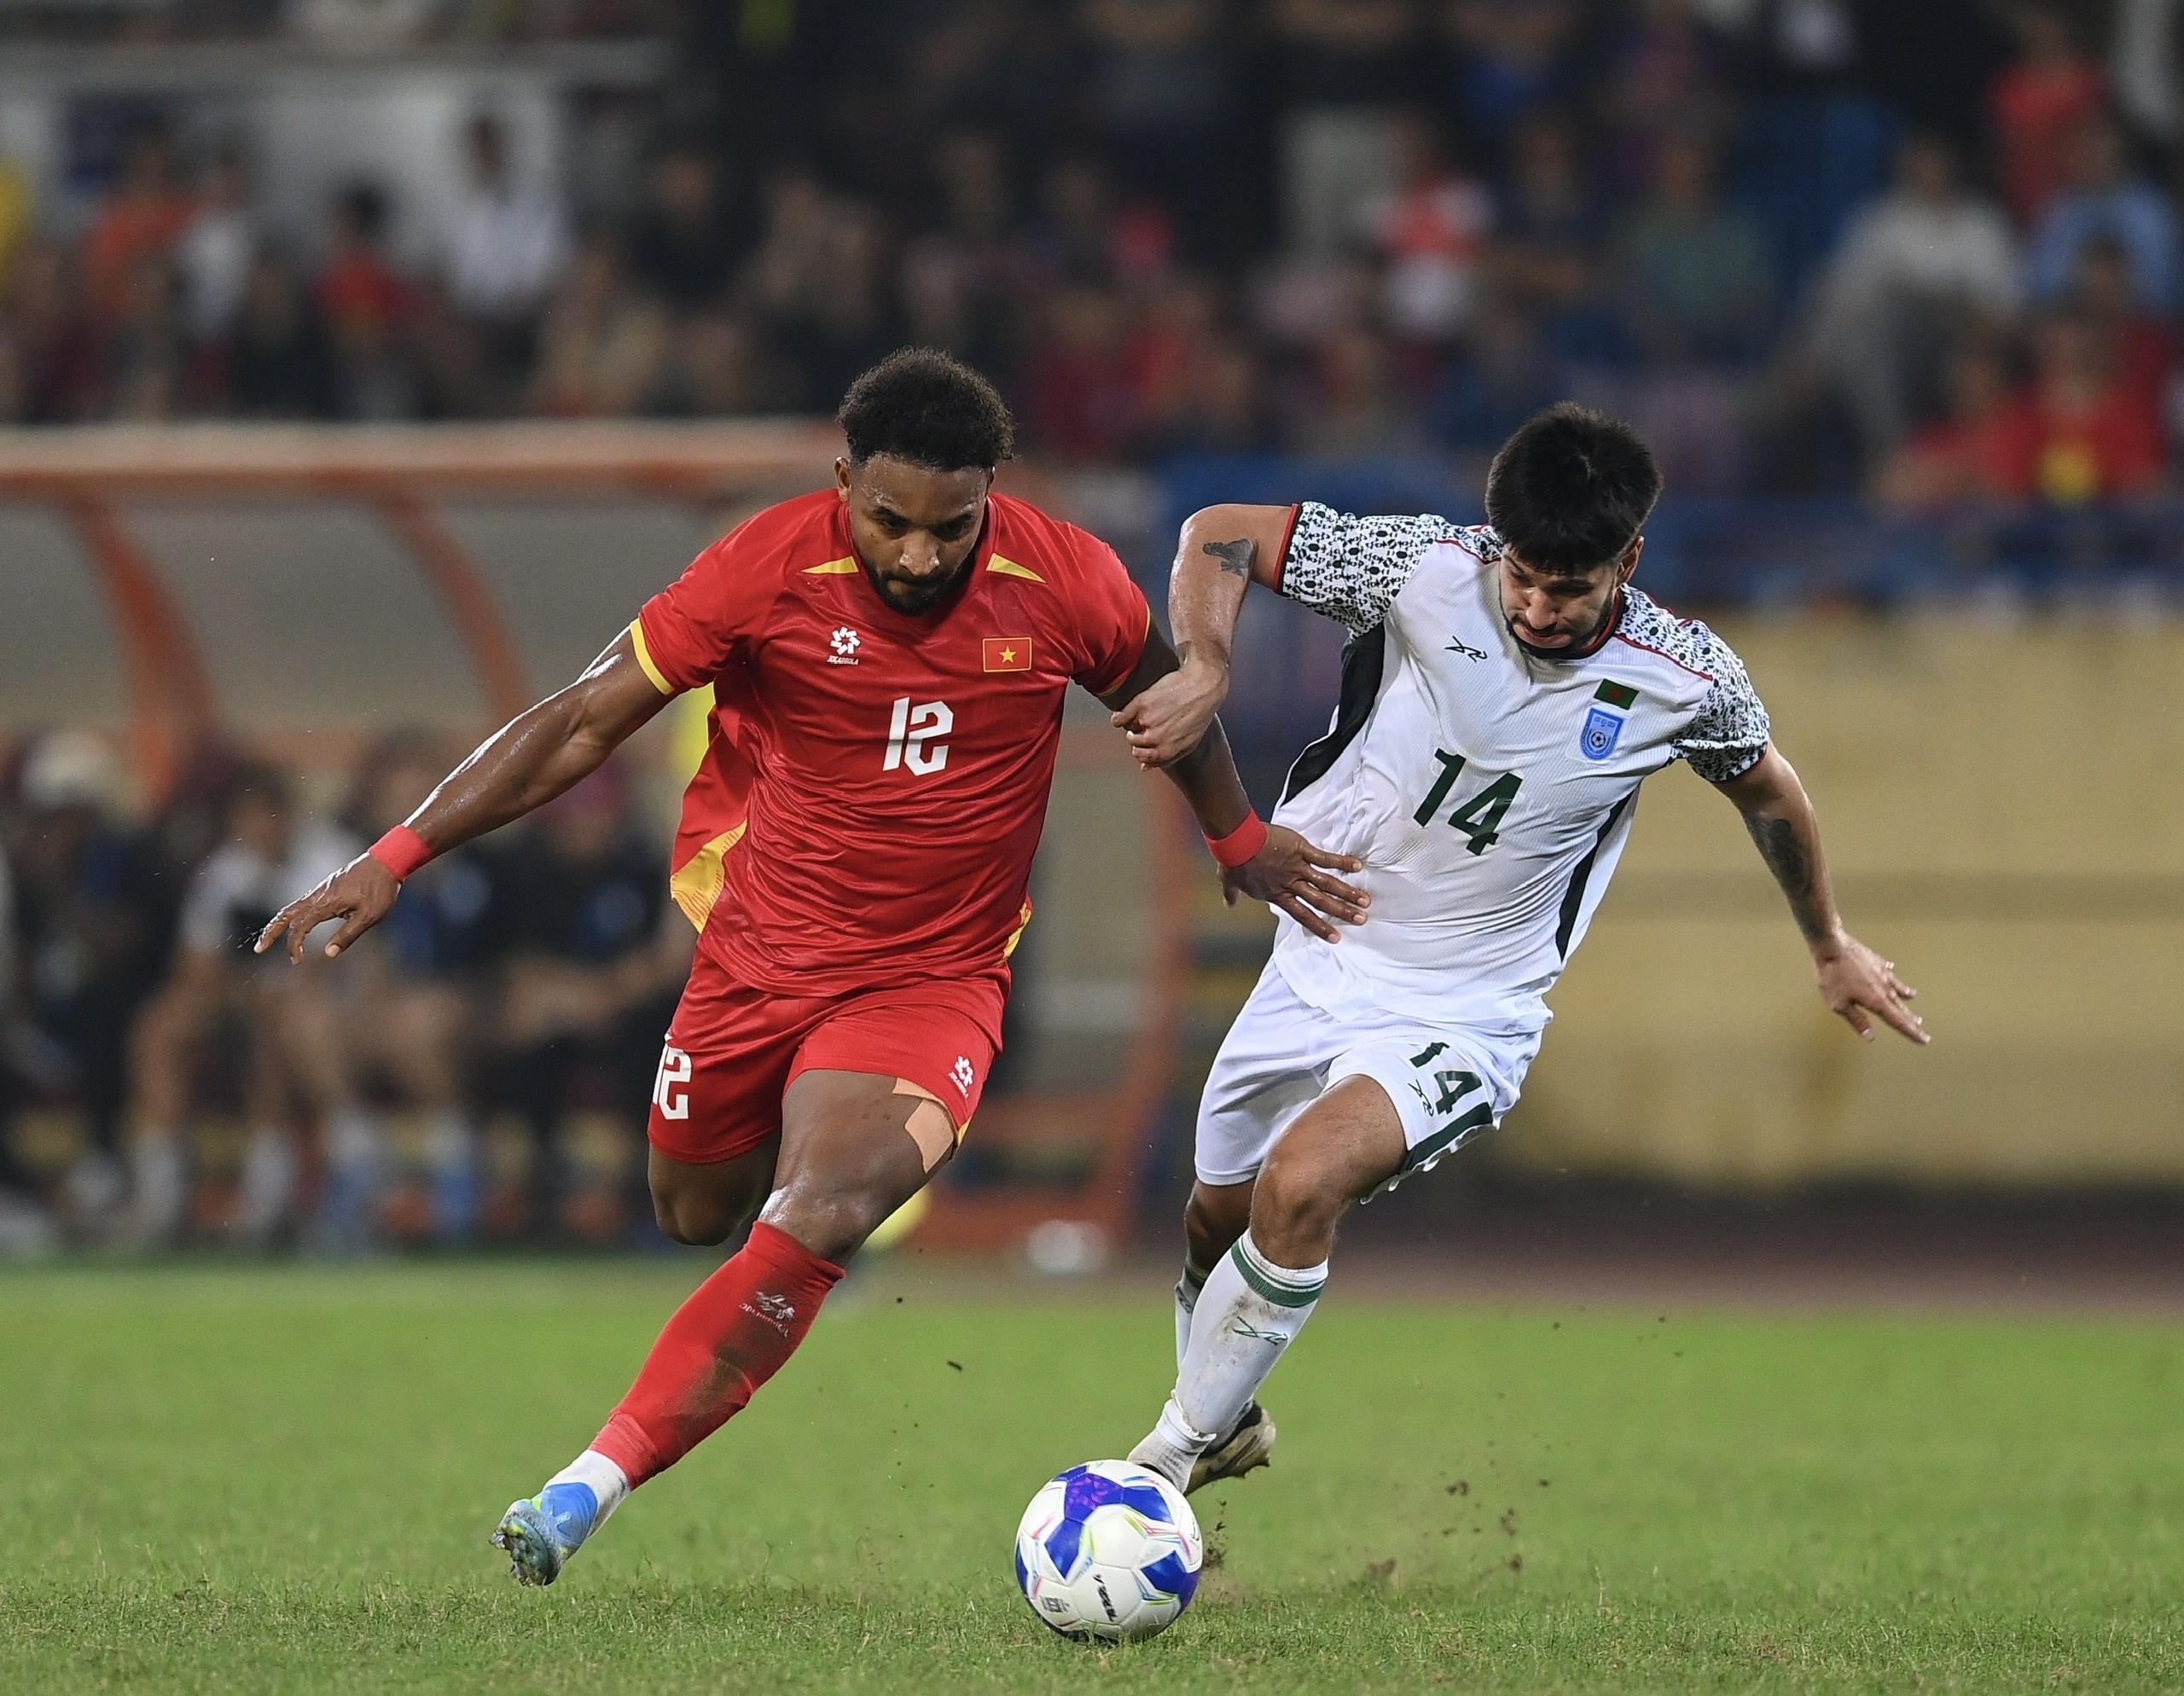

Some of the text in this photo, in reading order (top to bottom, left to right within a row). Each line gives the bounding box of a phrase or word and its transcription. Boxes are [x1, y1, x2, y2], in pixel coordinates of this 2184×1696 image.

[882, 696, 954, 776] 12
[1413, 747, 1524, 856] 14
[652, 1033, 692, 1120] 12
[1409, 1042, 1483, 1115] 14
